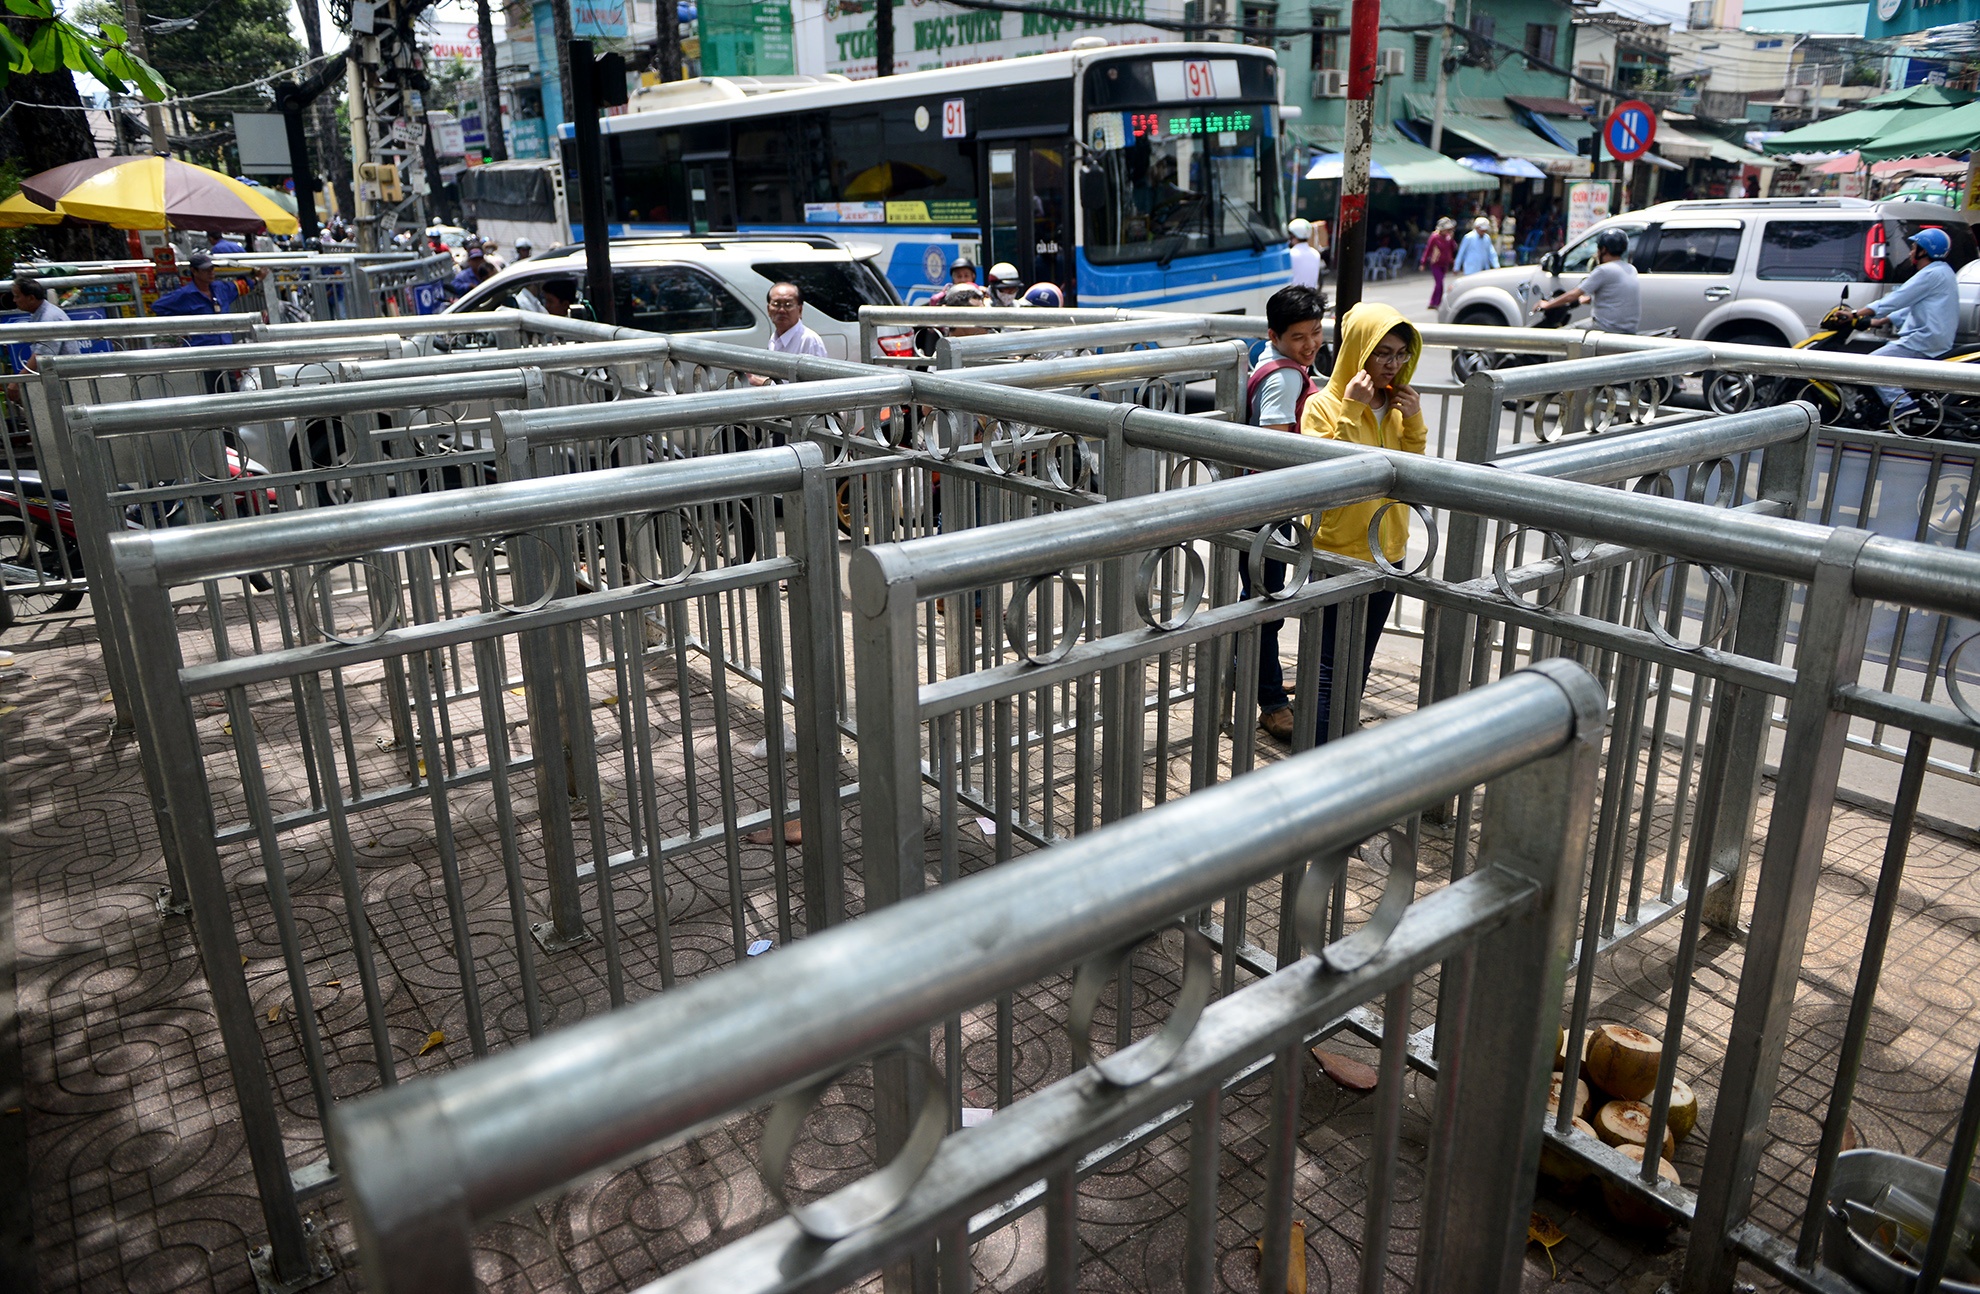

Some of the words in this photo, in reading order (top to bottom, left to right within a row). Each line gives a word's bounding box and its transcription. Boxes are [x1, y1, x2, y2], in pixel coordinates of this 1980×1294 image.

[433, 43, 472, 58] QUANG
[1189, 63, 1210, 96] 91
[946, 102, 963, 135] 91
